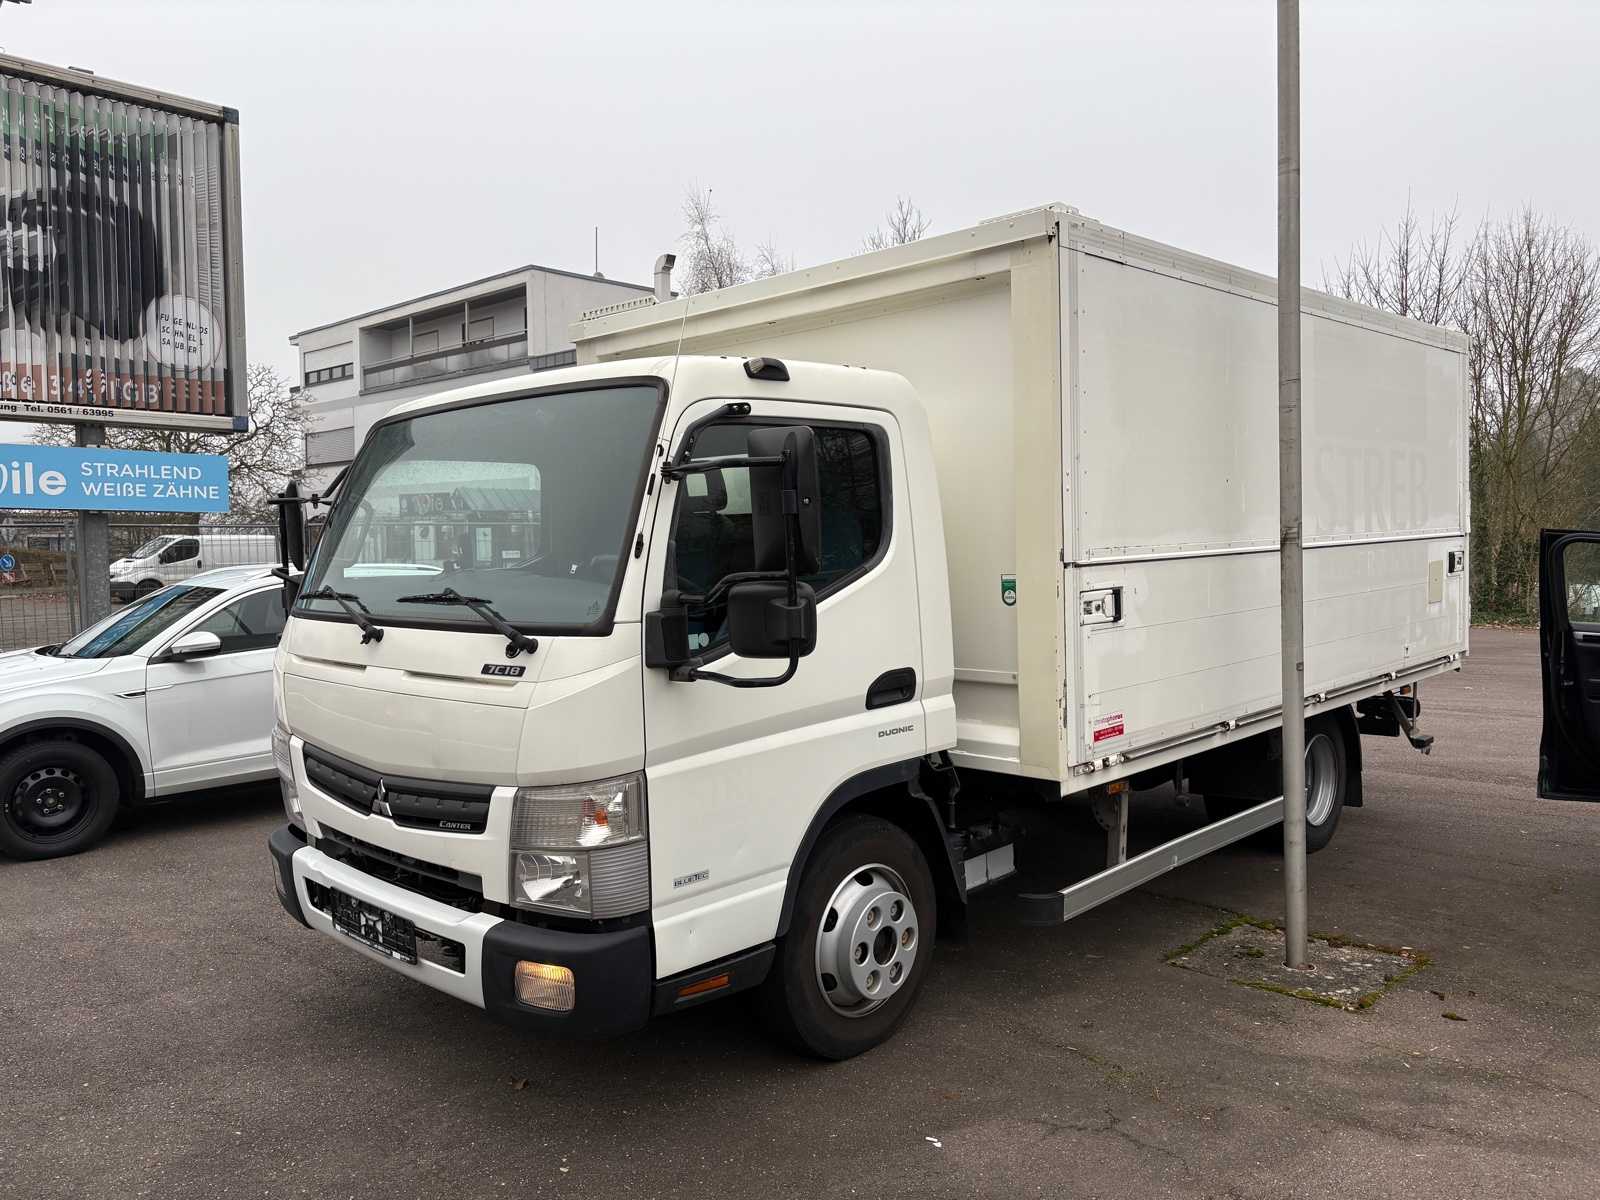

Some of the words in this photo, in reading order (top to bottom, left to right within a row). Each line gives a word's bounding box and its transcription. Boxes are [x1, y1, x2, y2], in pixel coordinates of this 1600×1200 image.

[24, 404, 43, 413] Tel.
[47, 406, 73, 415] 0561
[82, 408, 114, 417] 63995
[81, 462, 201, 480] STRAHLEND
[153, 481, 220, 499] ZÄHNE
[488, 665, 521, 676] 7C18
[878, 724, 914, 738] DUONIC
